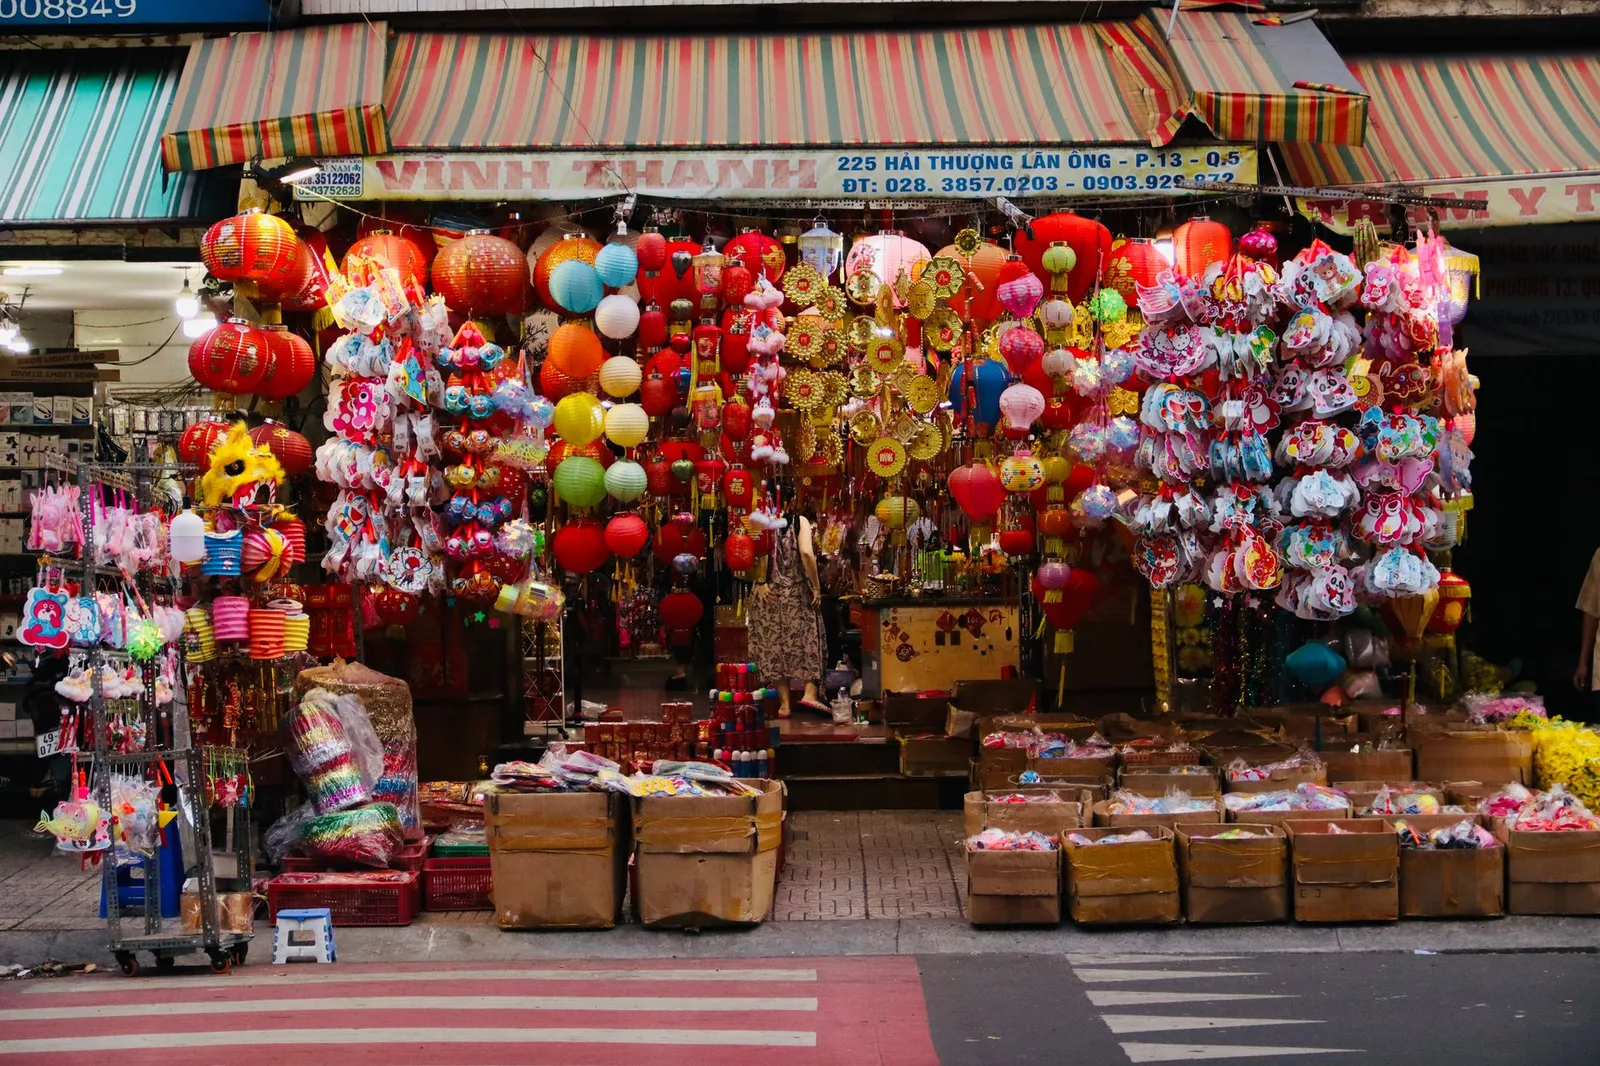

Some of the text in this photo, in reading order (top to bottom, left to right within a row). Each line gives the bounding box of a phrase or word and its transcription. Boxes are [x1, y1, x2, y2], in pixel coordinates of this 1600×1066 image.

[838, 156, 877, 171] 225
[885, 152, 920, 171] HẢI
[928, 153, 1013, 173] THƯỢNG
[1021, 152, 1060, 169] LÃN
[1068, 151, 1111, 168] ÔNG
[1136, 153, 1182, 168] P.13
[1206, 151, 1240, 167] Q.5
[842, 178, 877, 193] ĐT:
[885, 178, 933, 193] 028.
[941, 176, 1058, 192] 3857.0203
[1508, 187, 1546, 216] Y
